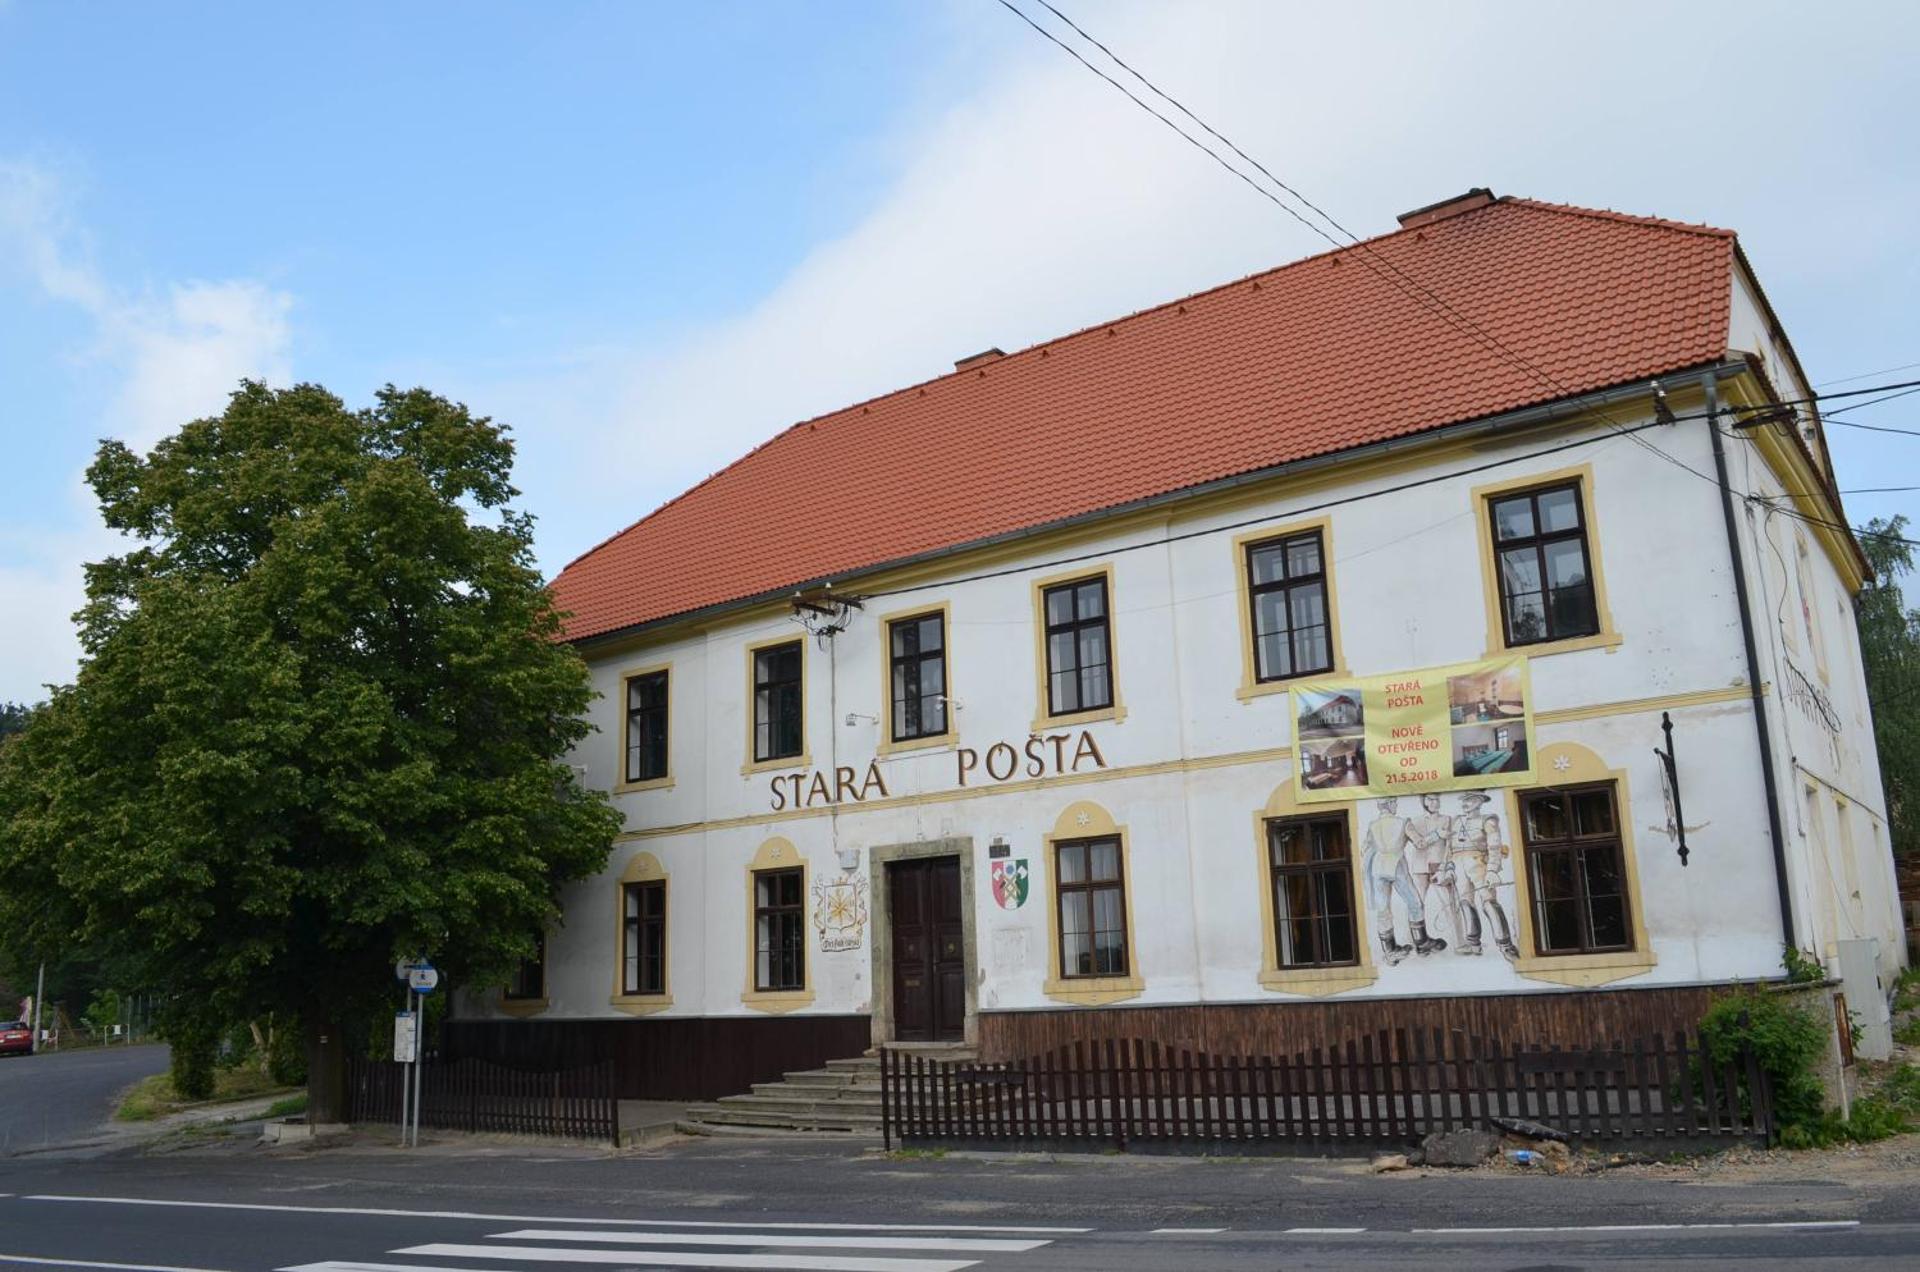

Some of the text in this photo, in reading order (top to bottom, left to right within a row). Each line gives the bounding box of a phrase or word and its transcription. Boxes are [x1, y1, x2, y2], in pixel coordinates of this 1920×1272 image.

[1385, 680, 1421, 693] STARÁ
[1388, 694, 1424, 708] POŠTA
[1378, 739, 1439, 754] OTEVŘENO
[1400, 757, 1417, 767] OD
[770, 730, 1106, 811] STARÁ POŠTA
[1386, 770, 1438, 784] 21.5.2018
